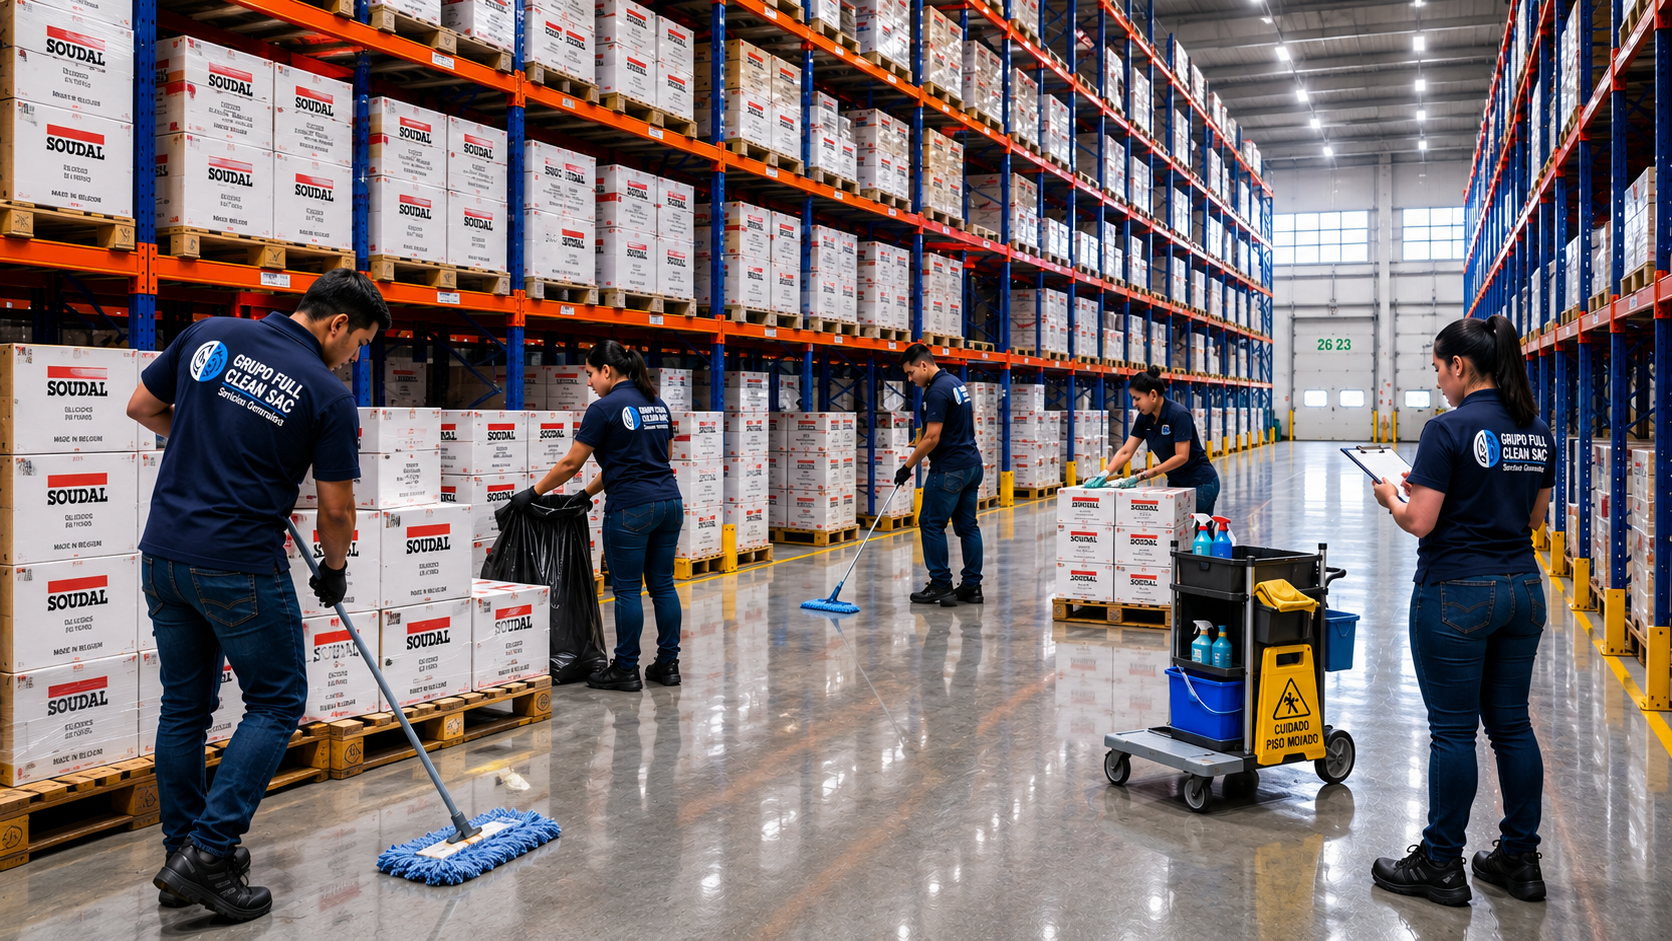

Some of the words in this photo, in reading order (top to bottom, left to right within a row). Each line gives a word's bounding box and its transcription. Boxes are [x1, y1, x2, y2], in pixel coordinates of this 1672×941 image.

[47, 39, 105, 66] SOUDAL
[209, 74, 253, 97] SOUDAL
[296, 97, 333, 116] SOUDAL
[400, 127, 431, 144] SOUDAL
[47, 137, 104, 160] SOUDAL
[464, 143, 493, 159] SOUDAL
[209, 168, 252, 187] SOUDAL
[295, 184, 333, 202] SOUDAL
[400, 204, 431, 219] SOUDAL
[464, 217, 493, 231] SOUDAL
[1317, 339, 1332, 350] 26
[1336, 339, 1351, 350] 23
[233, 354, 273, 380] GRUPO
[272, 372, 303, 400] FULL
[48, 381, 107, 396] SOUDAL
[225, 369, 267, 398] CLEAN
[265, 389, 295, 413] SAC
[1501, 433, 1527, 445] GRUPO
[1528, 435, 1547, 447] FULL
[1503, 447, 1529, 460] CLEAN
[1532, 449, 1548, 462] SAC
[48, 488, 108, 505] SOUDAL
[407, 537, 450, 554] SOUDAL
[48, 590, 108, 611] SOUDAL
[495, 616, 532, 635] SOUDAL
[407, 630, 450, 650] SOUDAL
[48, 691, 108, 716] SOUDAL
[1275, 720, 1309, 735] CUIDADO
[1267, 738, 1284, 750] PISO
